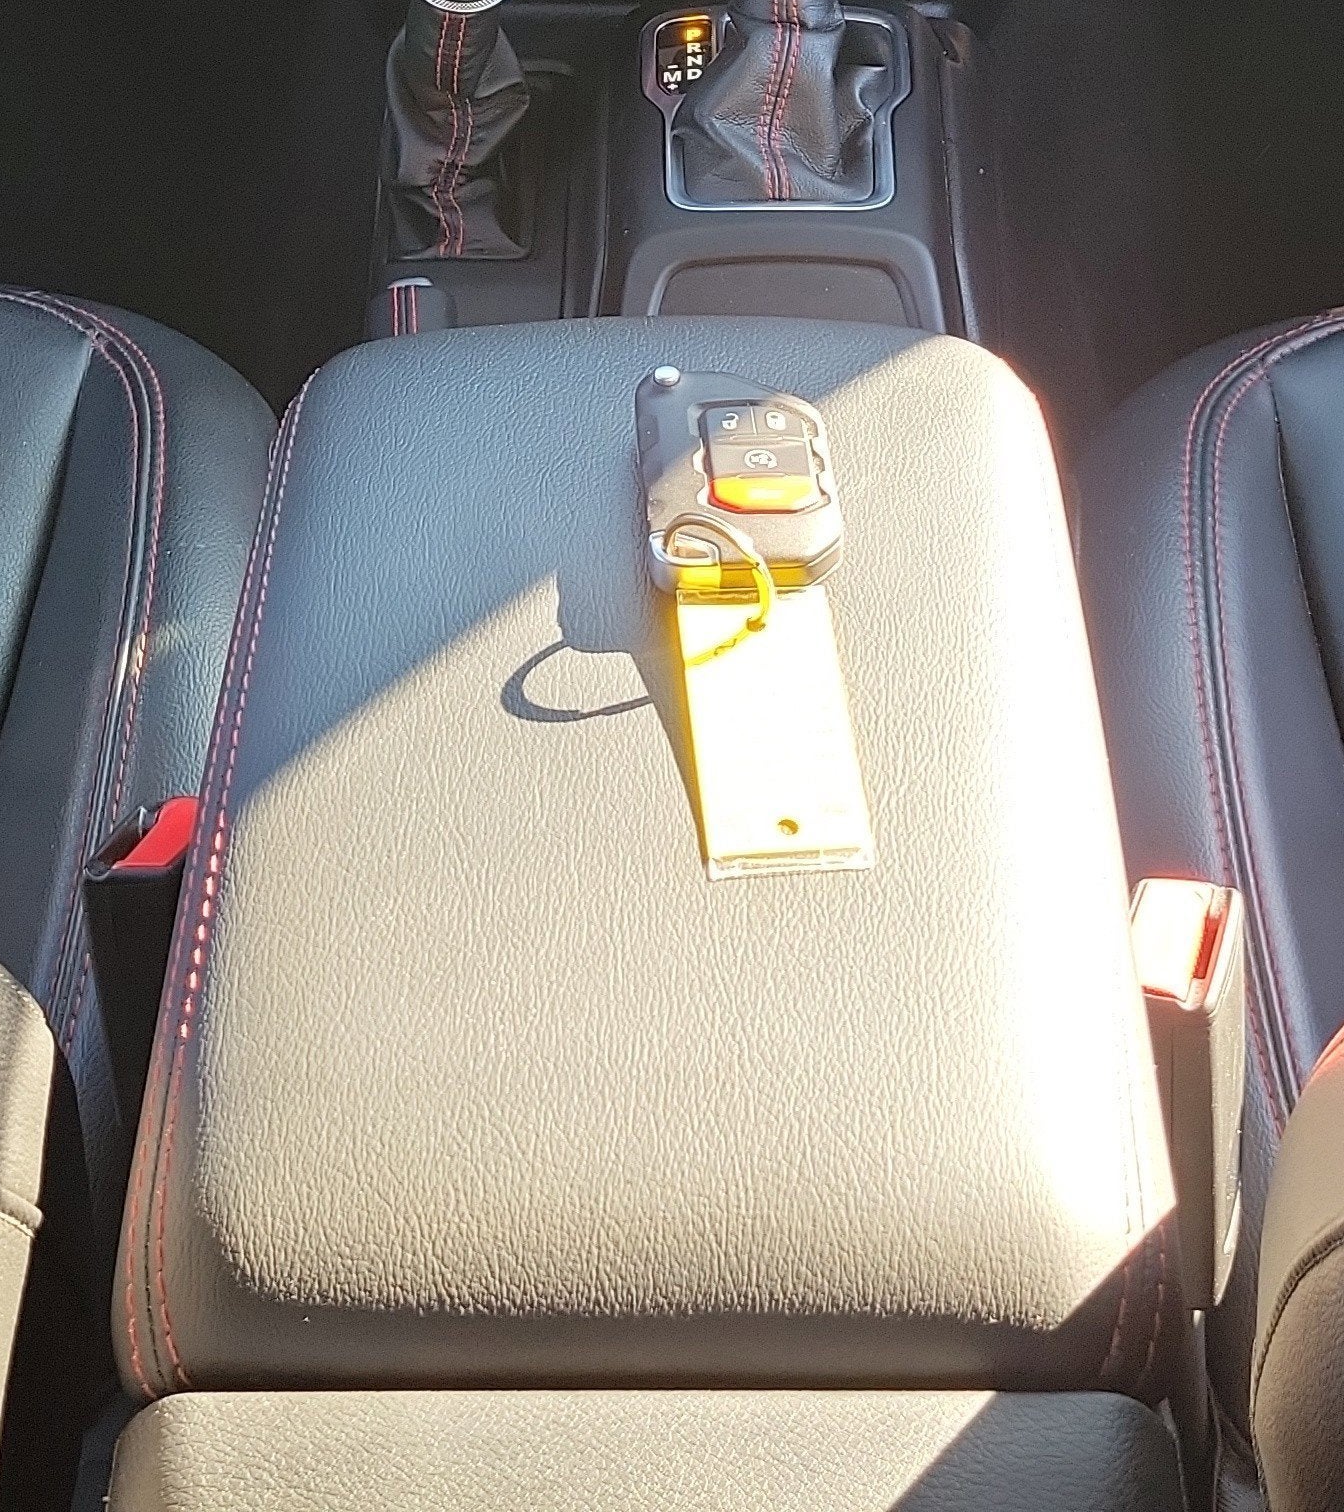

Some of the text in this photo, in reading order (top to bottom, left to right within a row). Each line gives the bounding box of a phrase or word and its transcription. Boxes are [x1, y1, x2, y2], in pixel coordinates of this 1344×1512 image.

[686, 29, 702, 42] P
[686, 42, 702, 54] R
[686, 54, 703, 67] N
[663, 70, 682, 83] M
[686, 68, 703, 81] D
